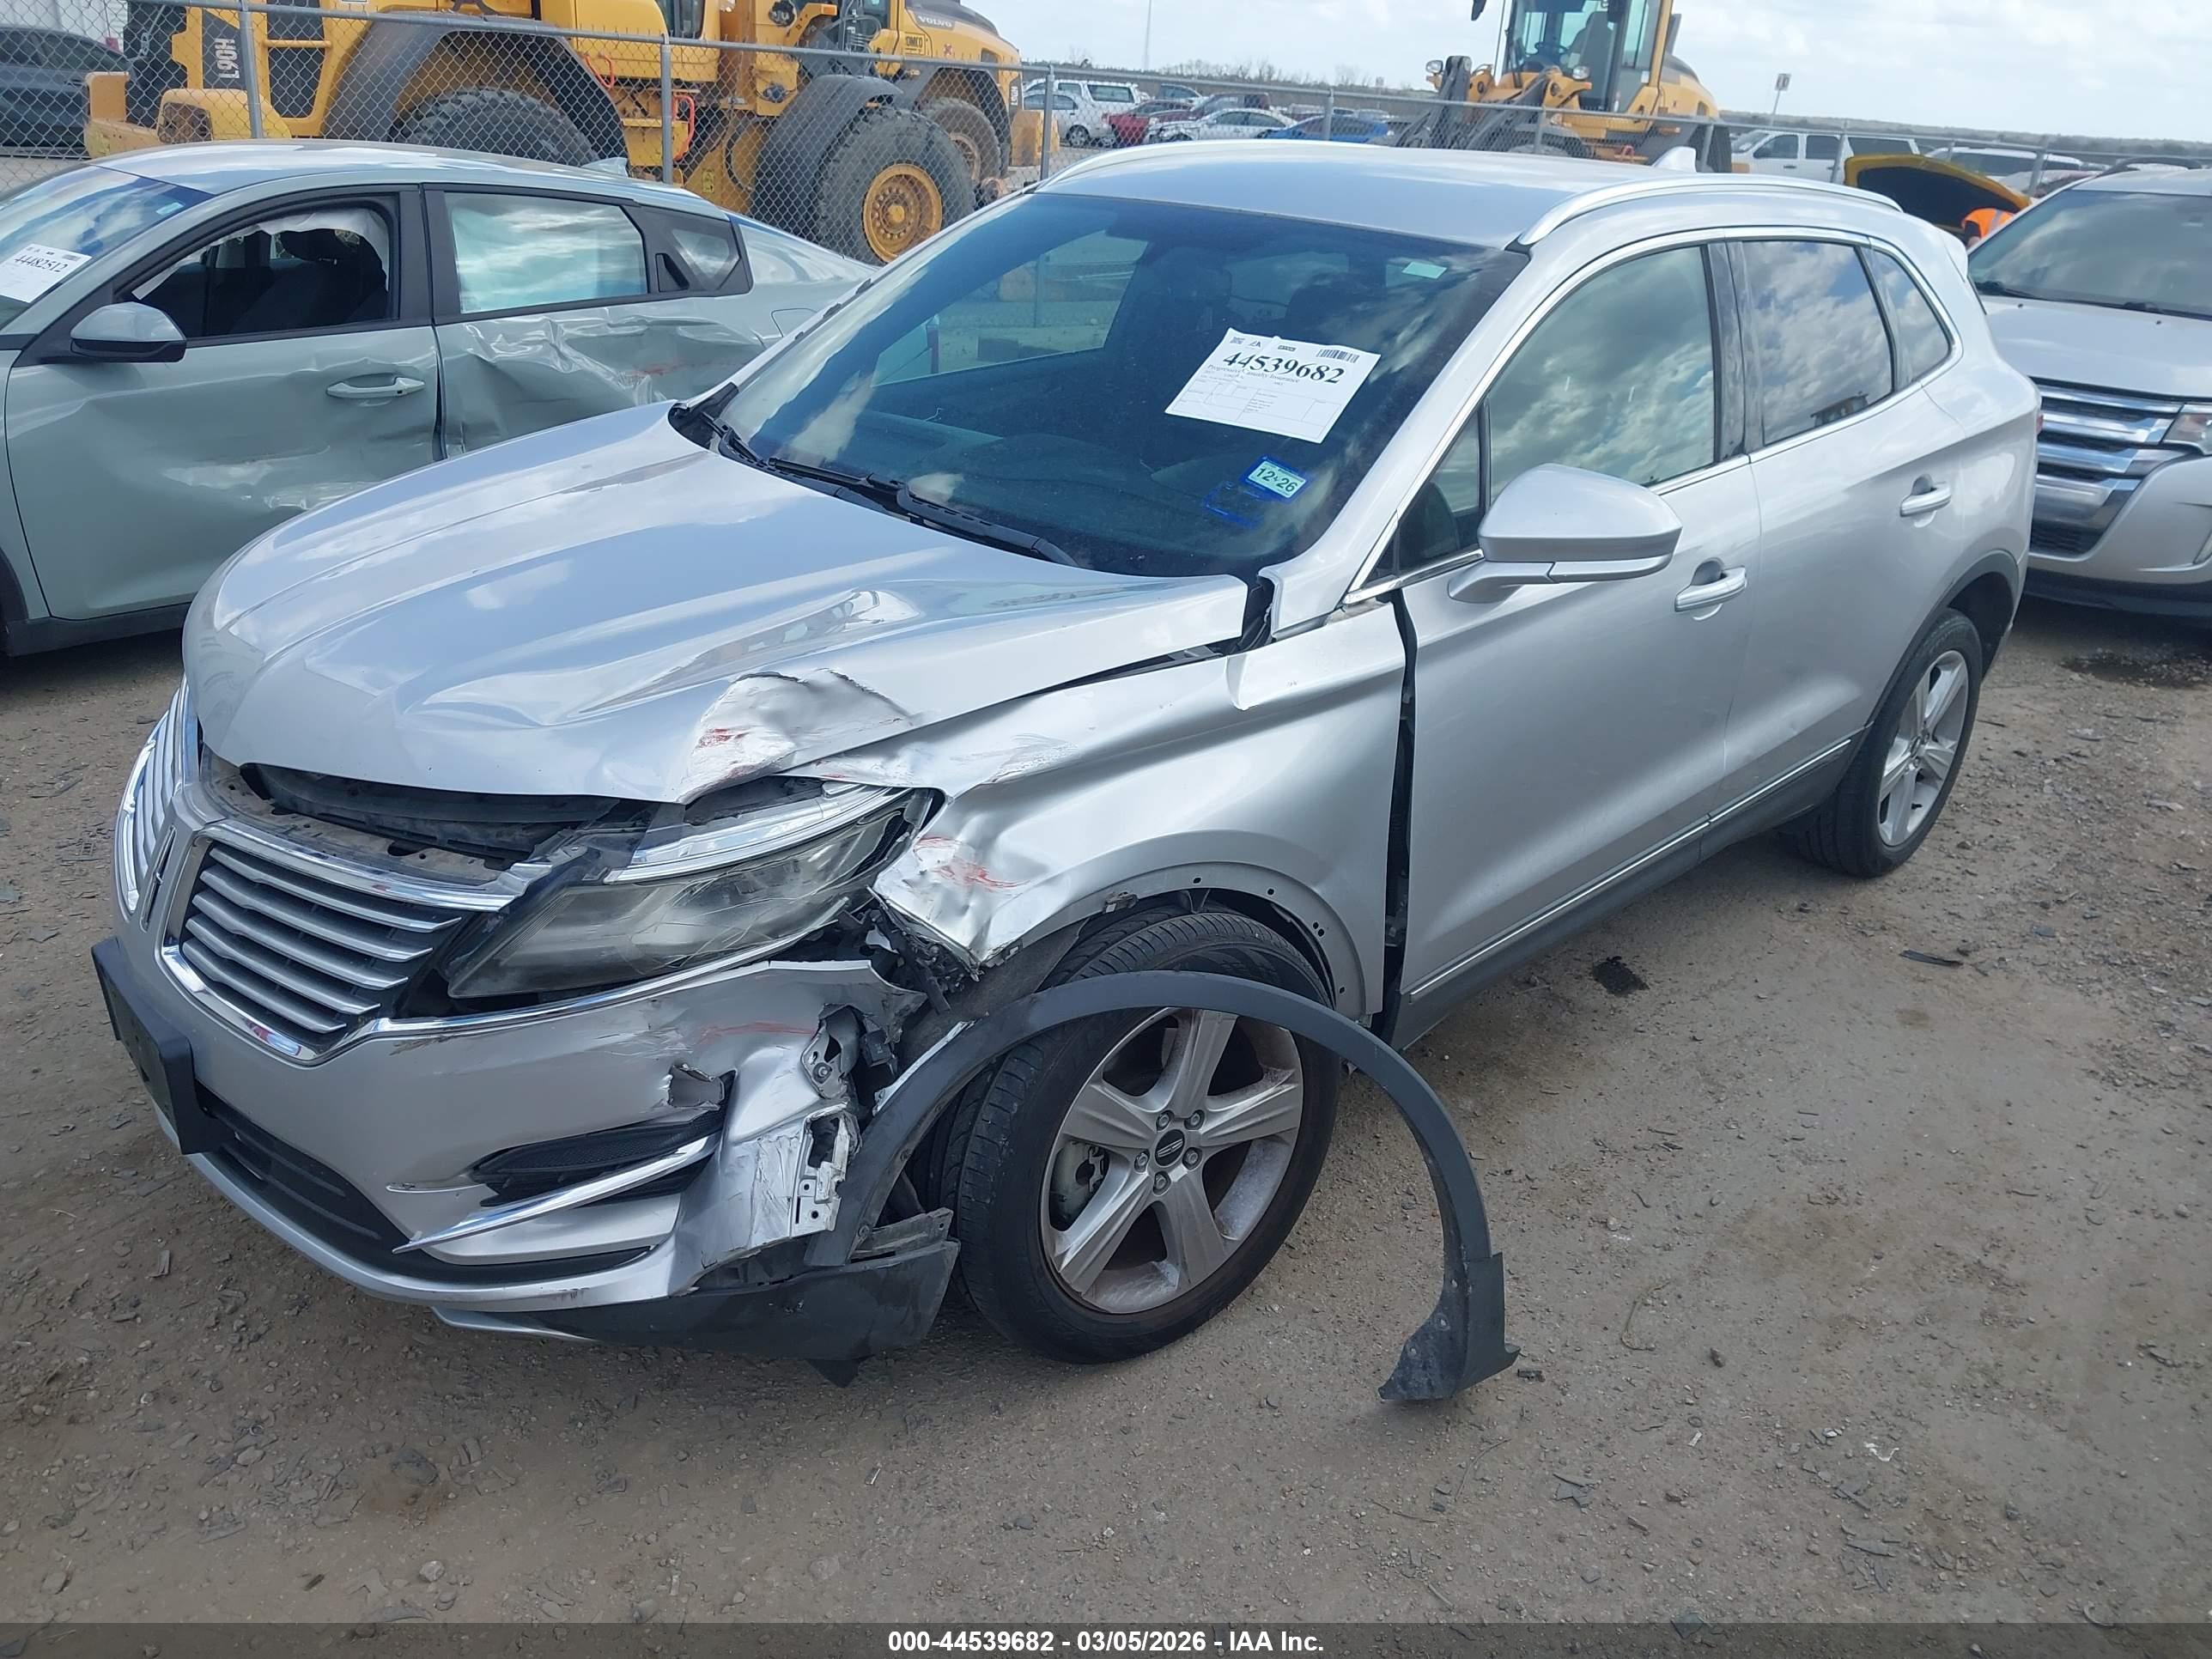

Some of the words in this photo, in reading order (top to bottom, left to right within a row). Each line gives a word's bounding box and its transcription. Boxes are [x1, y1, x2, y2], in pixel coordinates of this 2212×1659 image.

[918, 15, 952, 27] VOLVO
[214, 38, 240, 78] L90H
[1223, 352, 1346, 384] 44539682
